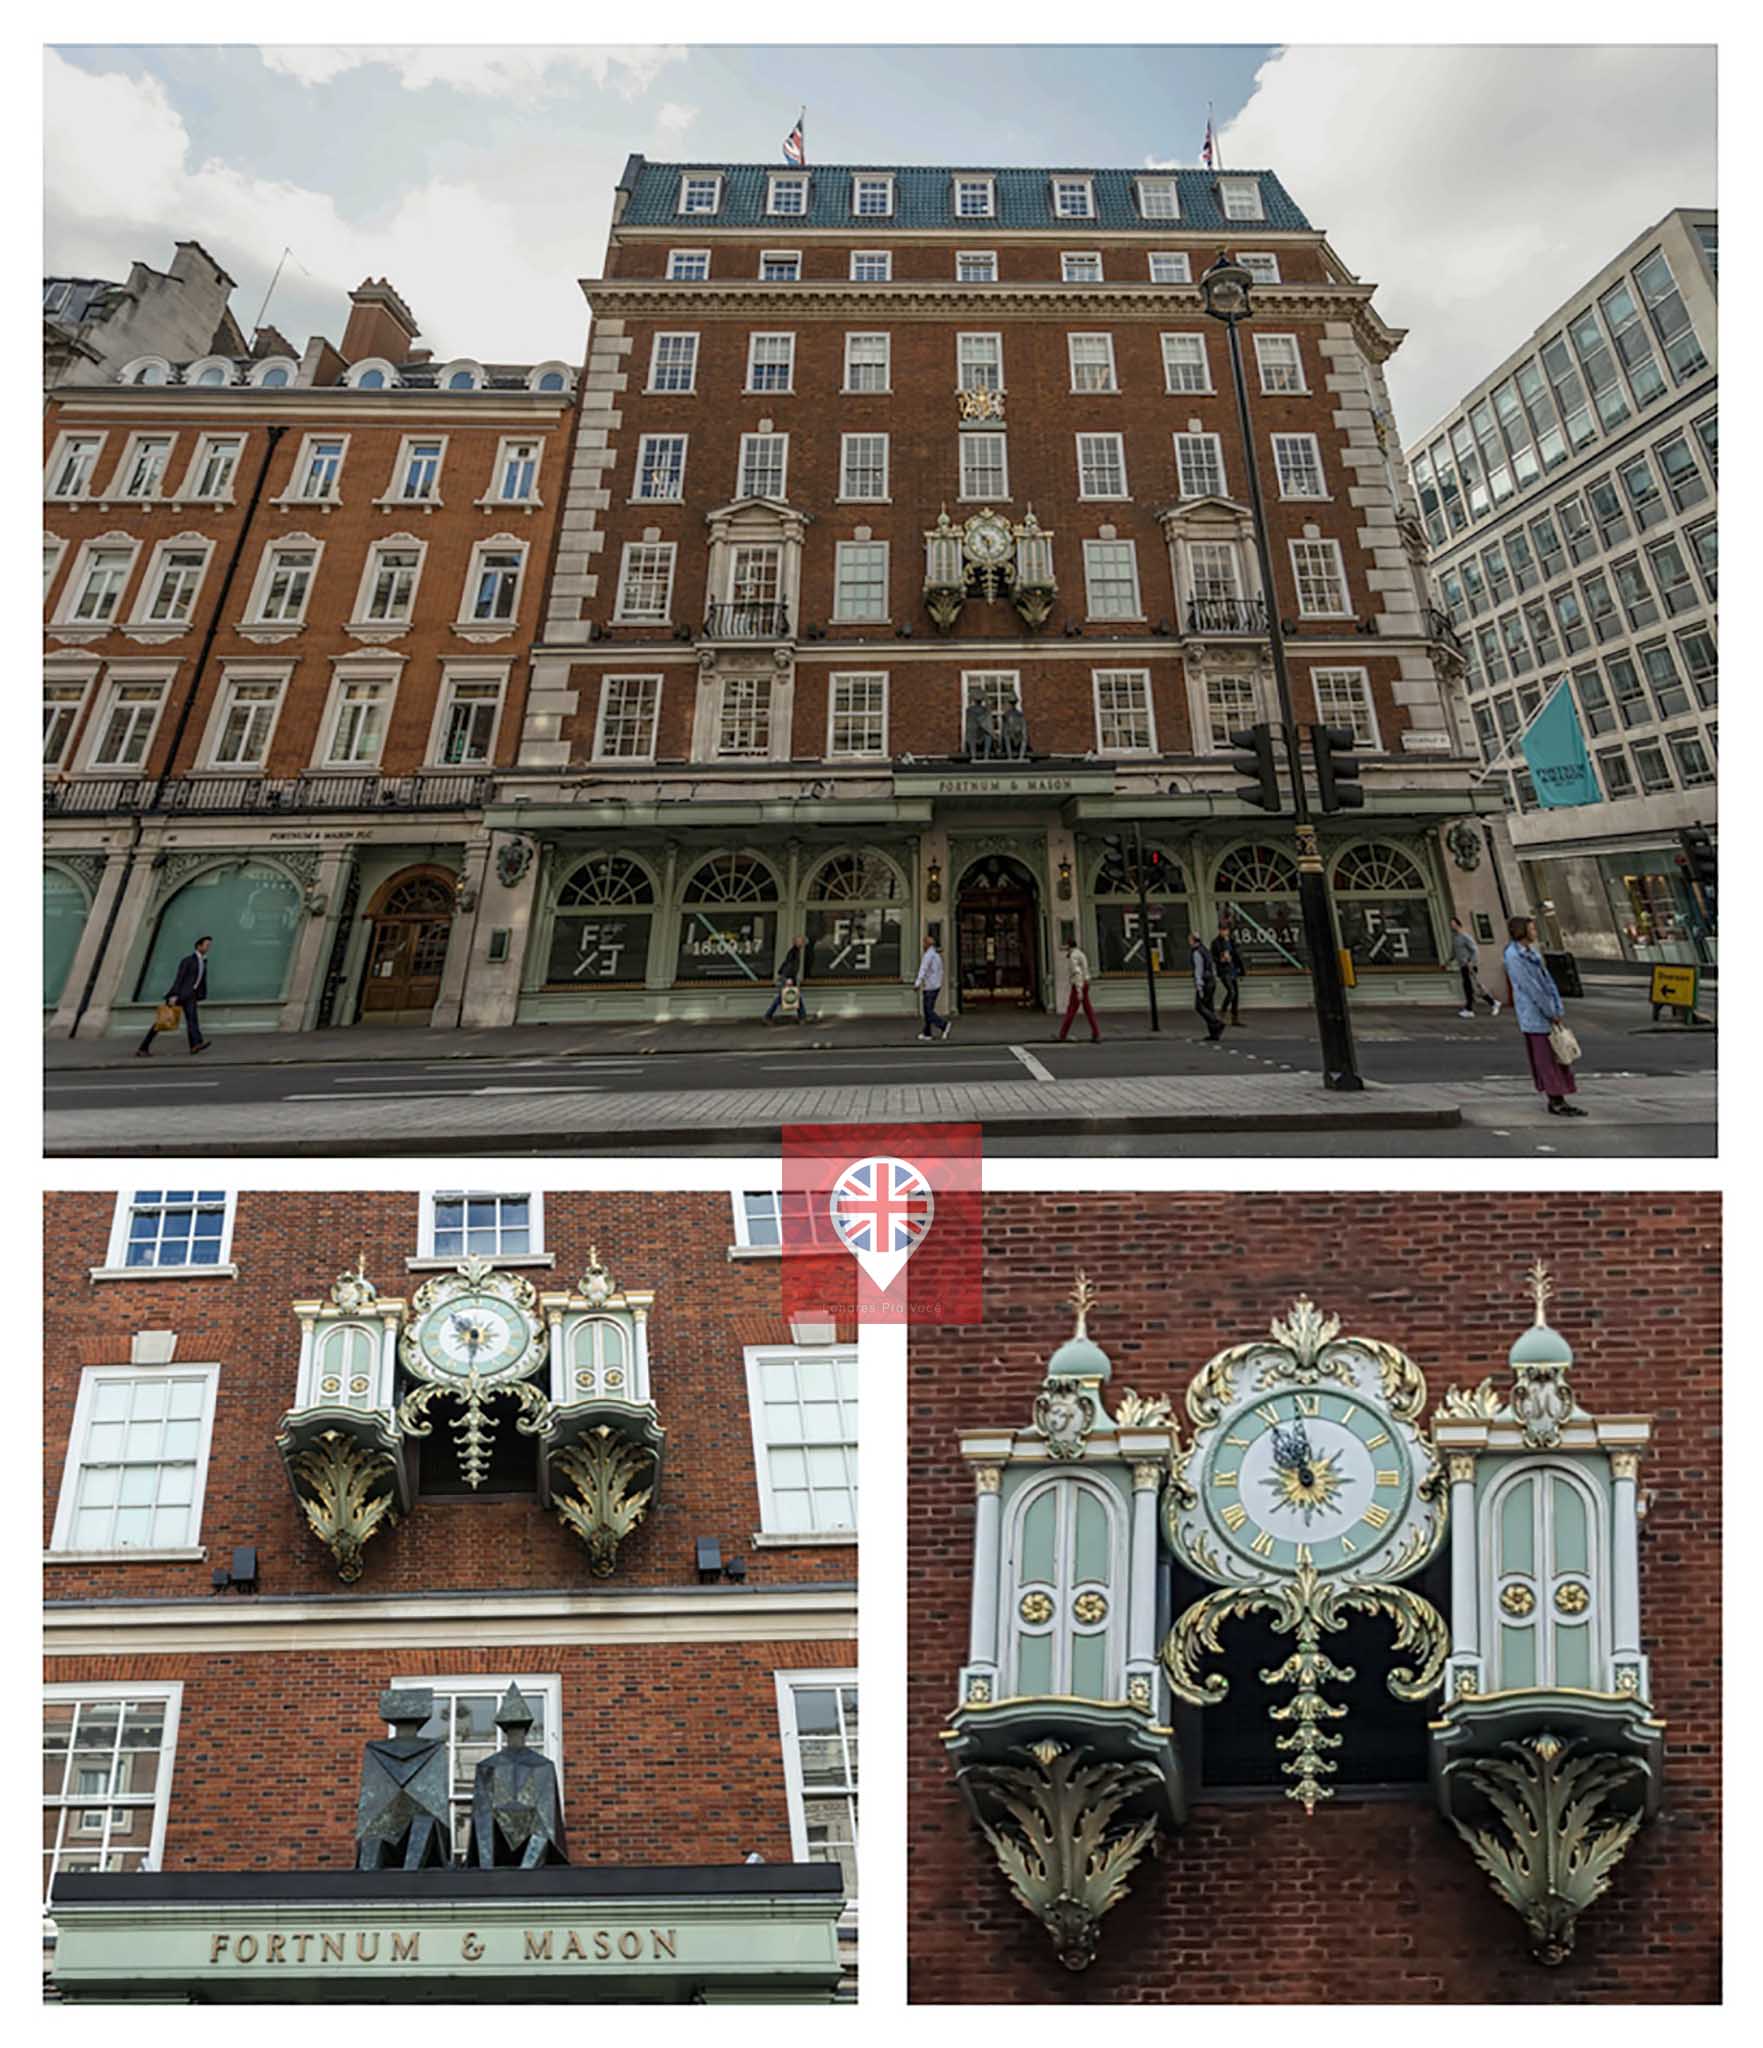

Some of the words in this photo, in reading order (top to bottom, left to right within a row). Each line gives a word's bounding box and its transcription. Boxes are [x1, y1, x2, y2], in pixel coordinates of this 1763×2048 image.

[209, 1932, 421, 1963] FORTNUM
[461, 1931, 485, 1961] &
[523, 1929, 677, 1961] MASON
